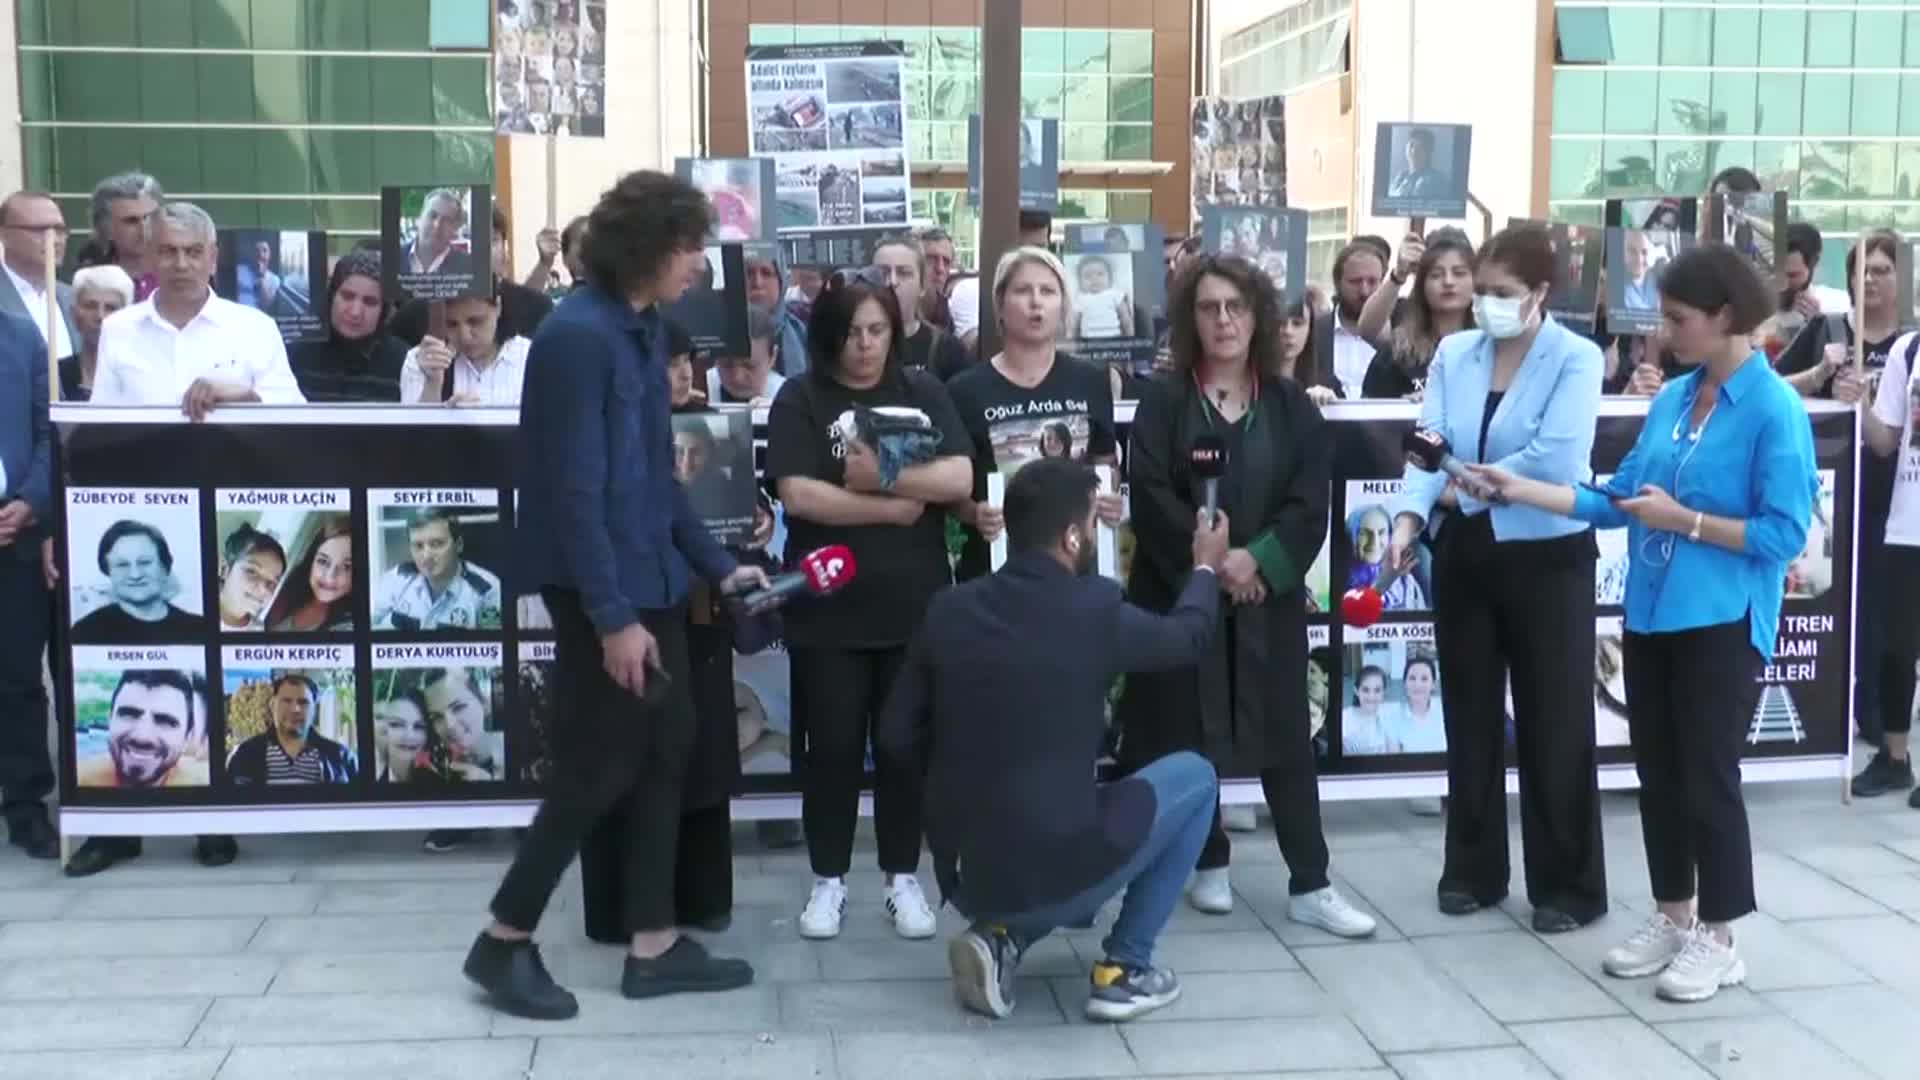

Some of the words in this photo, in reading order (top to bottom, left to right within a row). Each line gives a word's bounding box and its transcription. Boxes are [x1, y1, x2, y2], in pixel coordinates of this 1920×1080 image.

[984, 404, 1024, 420] Oğuz
[1027, 400, 1063, 413] Arda
[72, 491, 136, 504] ZÜBEYDE
[144, 493, 188, 504] SEVEN
[228, 491, 289, 504] YAĞMUR
[293, 491, 336, 506] LAÇİN
[394, 490, 432, 503] SEYFİ
[437, 490, 476, 503] ERBİL
[1785, 615, 1834, 633] TREN
[1368, 628, 1399, 638] SENA
[107, 650, 144, 660] ERSEN
[146, 649, 168, 660] GÜL
[235, 646, 284, 660] ERGÜN
[288, 646, 342, 662] KERPİÇ
[376, 647, 423, 659] DERYA
[426, 646, 499, 659] KURTULUŞ
